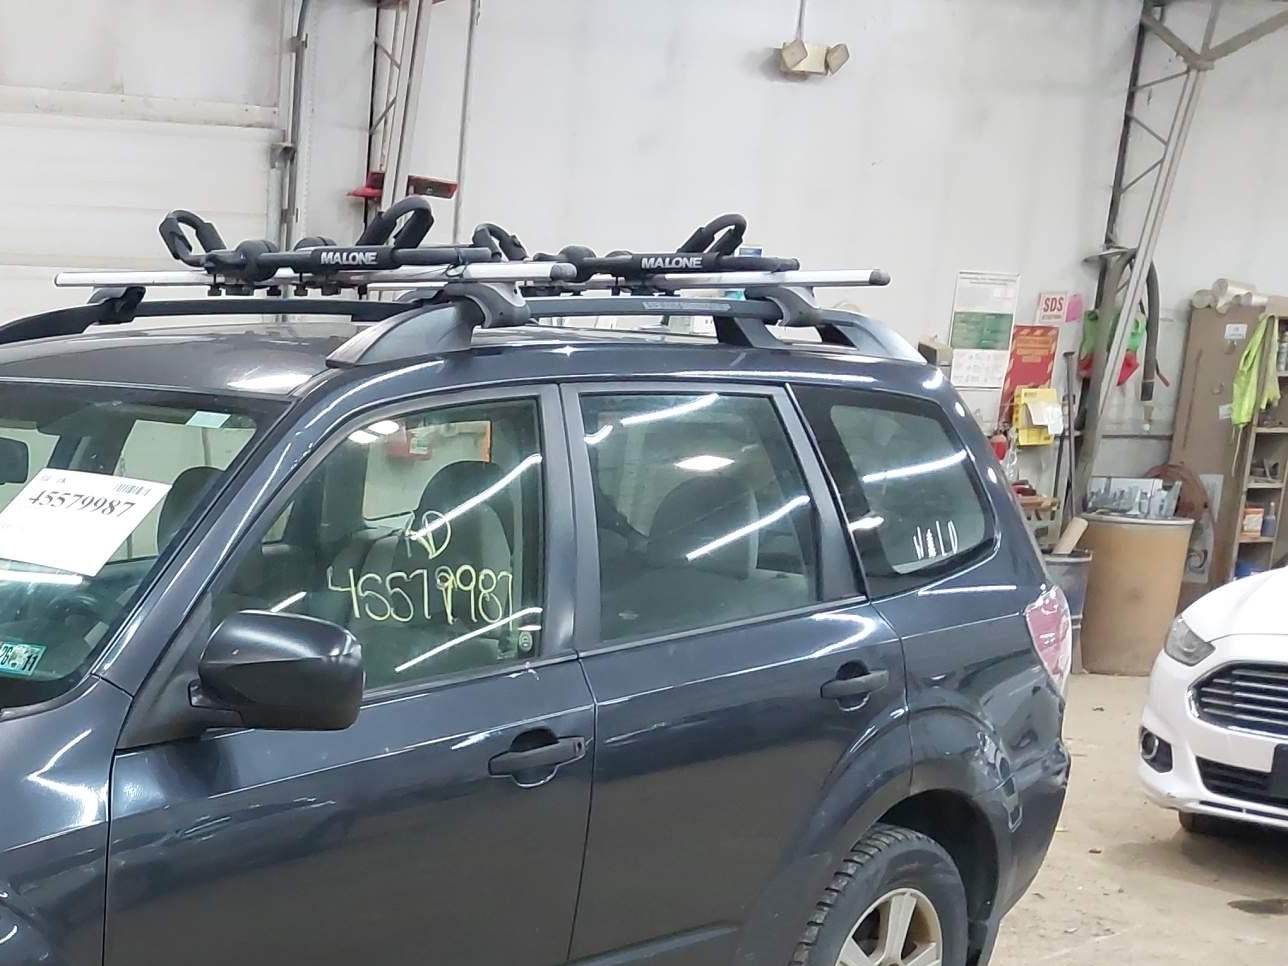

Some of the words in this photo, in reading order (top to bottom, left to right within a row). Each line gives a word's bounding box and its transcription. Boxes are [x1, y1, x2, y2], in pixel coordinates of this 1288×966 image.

[320, 251, 378, 265] MALONE
[641, 257, 703, 269] MALONE
[1043, 297, 1064, 312] SDS
[28, 490, 137, 517] 45579987
[326, 564, 513, 631] 45579987
[22, 654, 39, 671] 11
